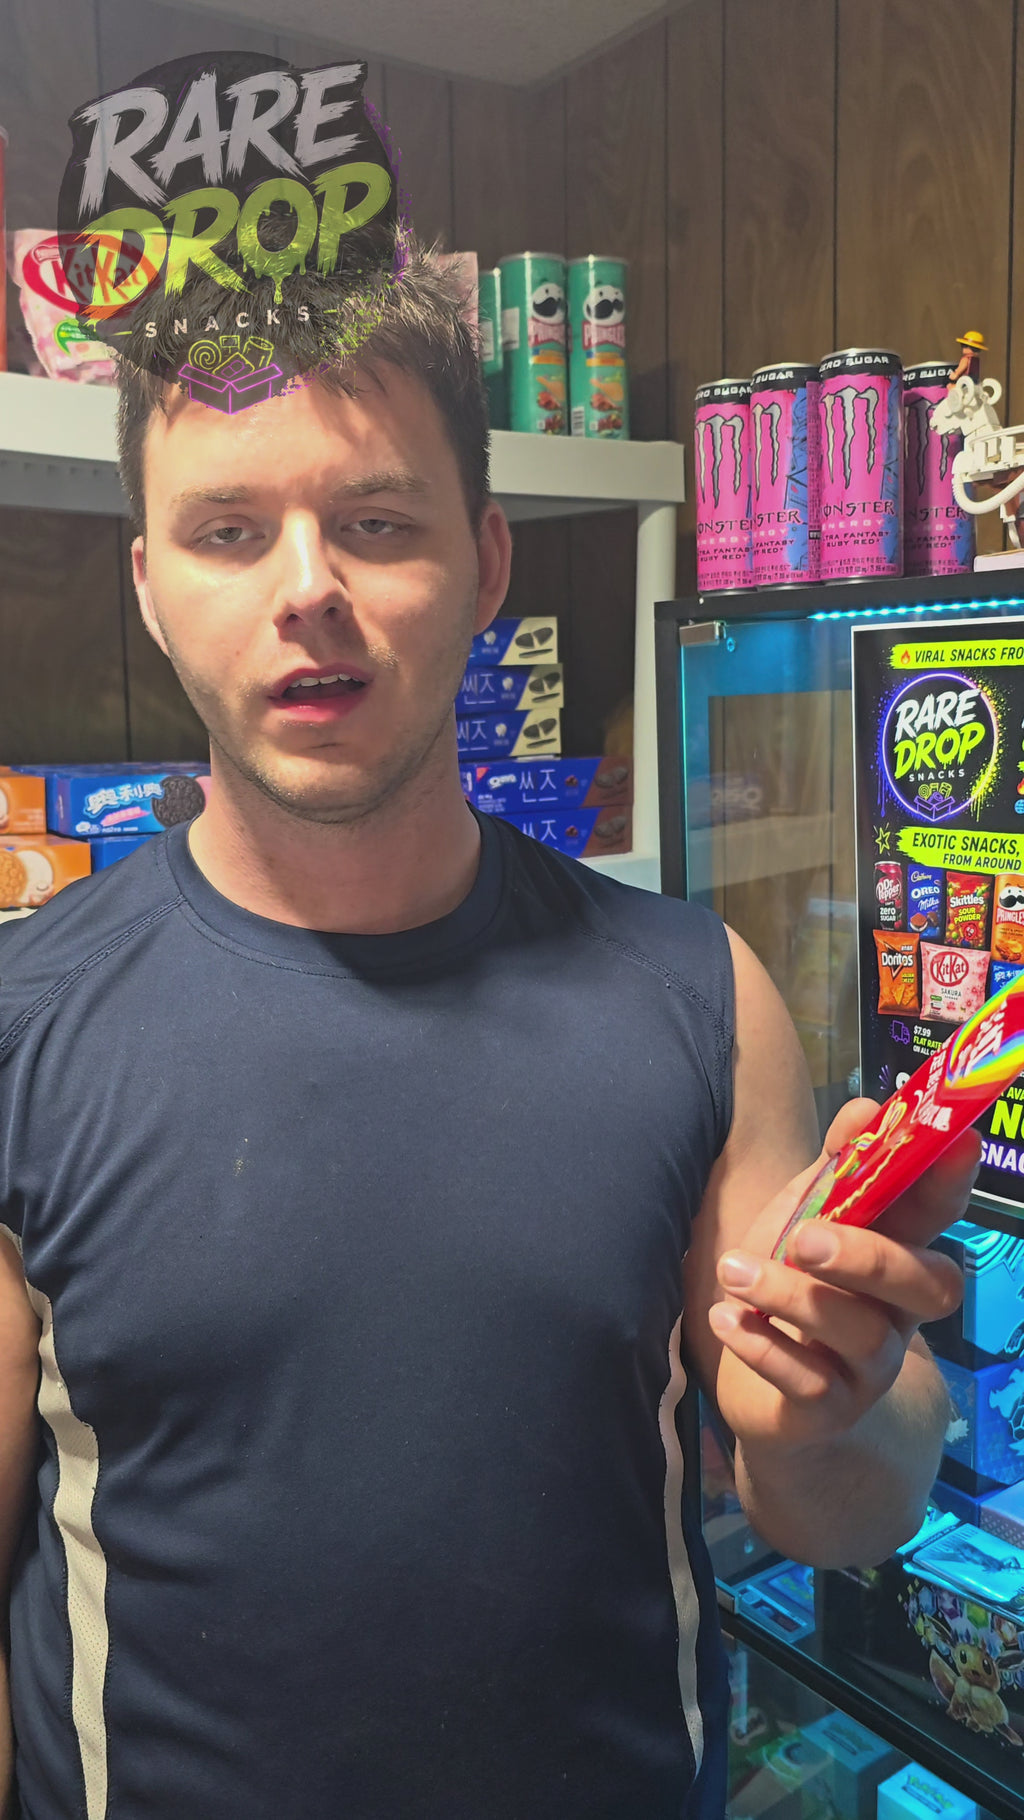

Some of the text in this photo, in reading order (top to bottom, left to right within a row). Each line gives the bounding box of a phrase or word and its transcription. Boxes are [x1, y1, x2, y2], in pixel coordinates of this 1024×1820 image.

[846, 356, 889, 366] SUGAR
[755, 371, 794, 384] SUGAR
[920, 368, 954, 379] SUGA
[822, 501, 895, 521] ONSTER
[756, 510, 801, 528] STER
[697, 519, 753, 535] ONSTE
[915, 650, 945, 662] VIRAL
[950, 648, 996, 661] SNACKS
[895, 688, 981, 742] RARE
[893, 722, 986, 780] DROP
[908, 769, 965, 782] SNACKS
[912, 833, 1020, 857] EXOTIC SNACKS,
[943, 854, 1022, 871] FROM AROUND
[883, 879, 894, 889] Dr
[911, 886, 940, 899] OREO
[949, 895, 984, 908] Skittles
[958, 907, 976, 916] SOUR
[954, 913, 981, 924] POWDER
[881, 952, 914, 967] Doritos
[934, 954, 965, 983] KitKat
[941, 987, 962, 997] SAKURA
[913, 1025, 932, 1038] $7.99
[913, 1036, 926, 1046] FLAT
